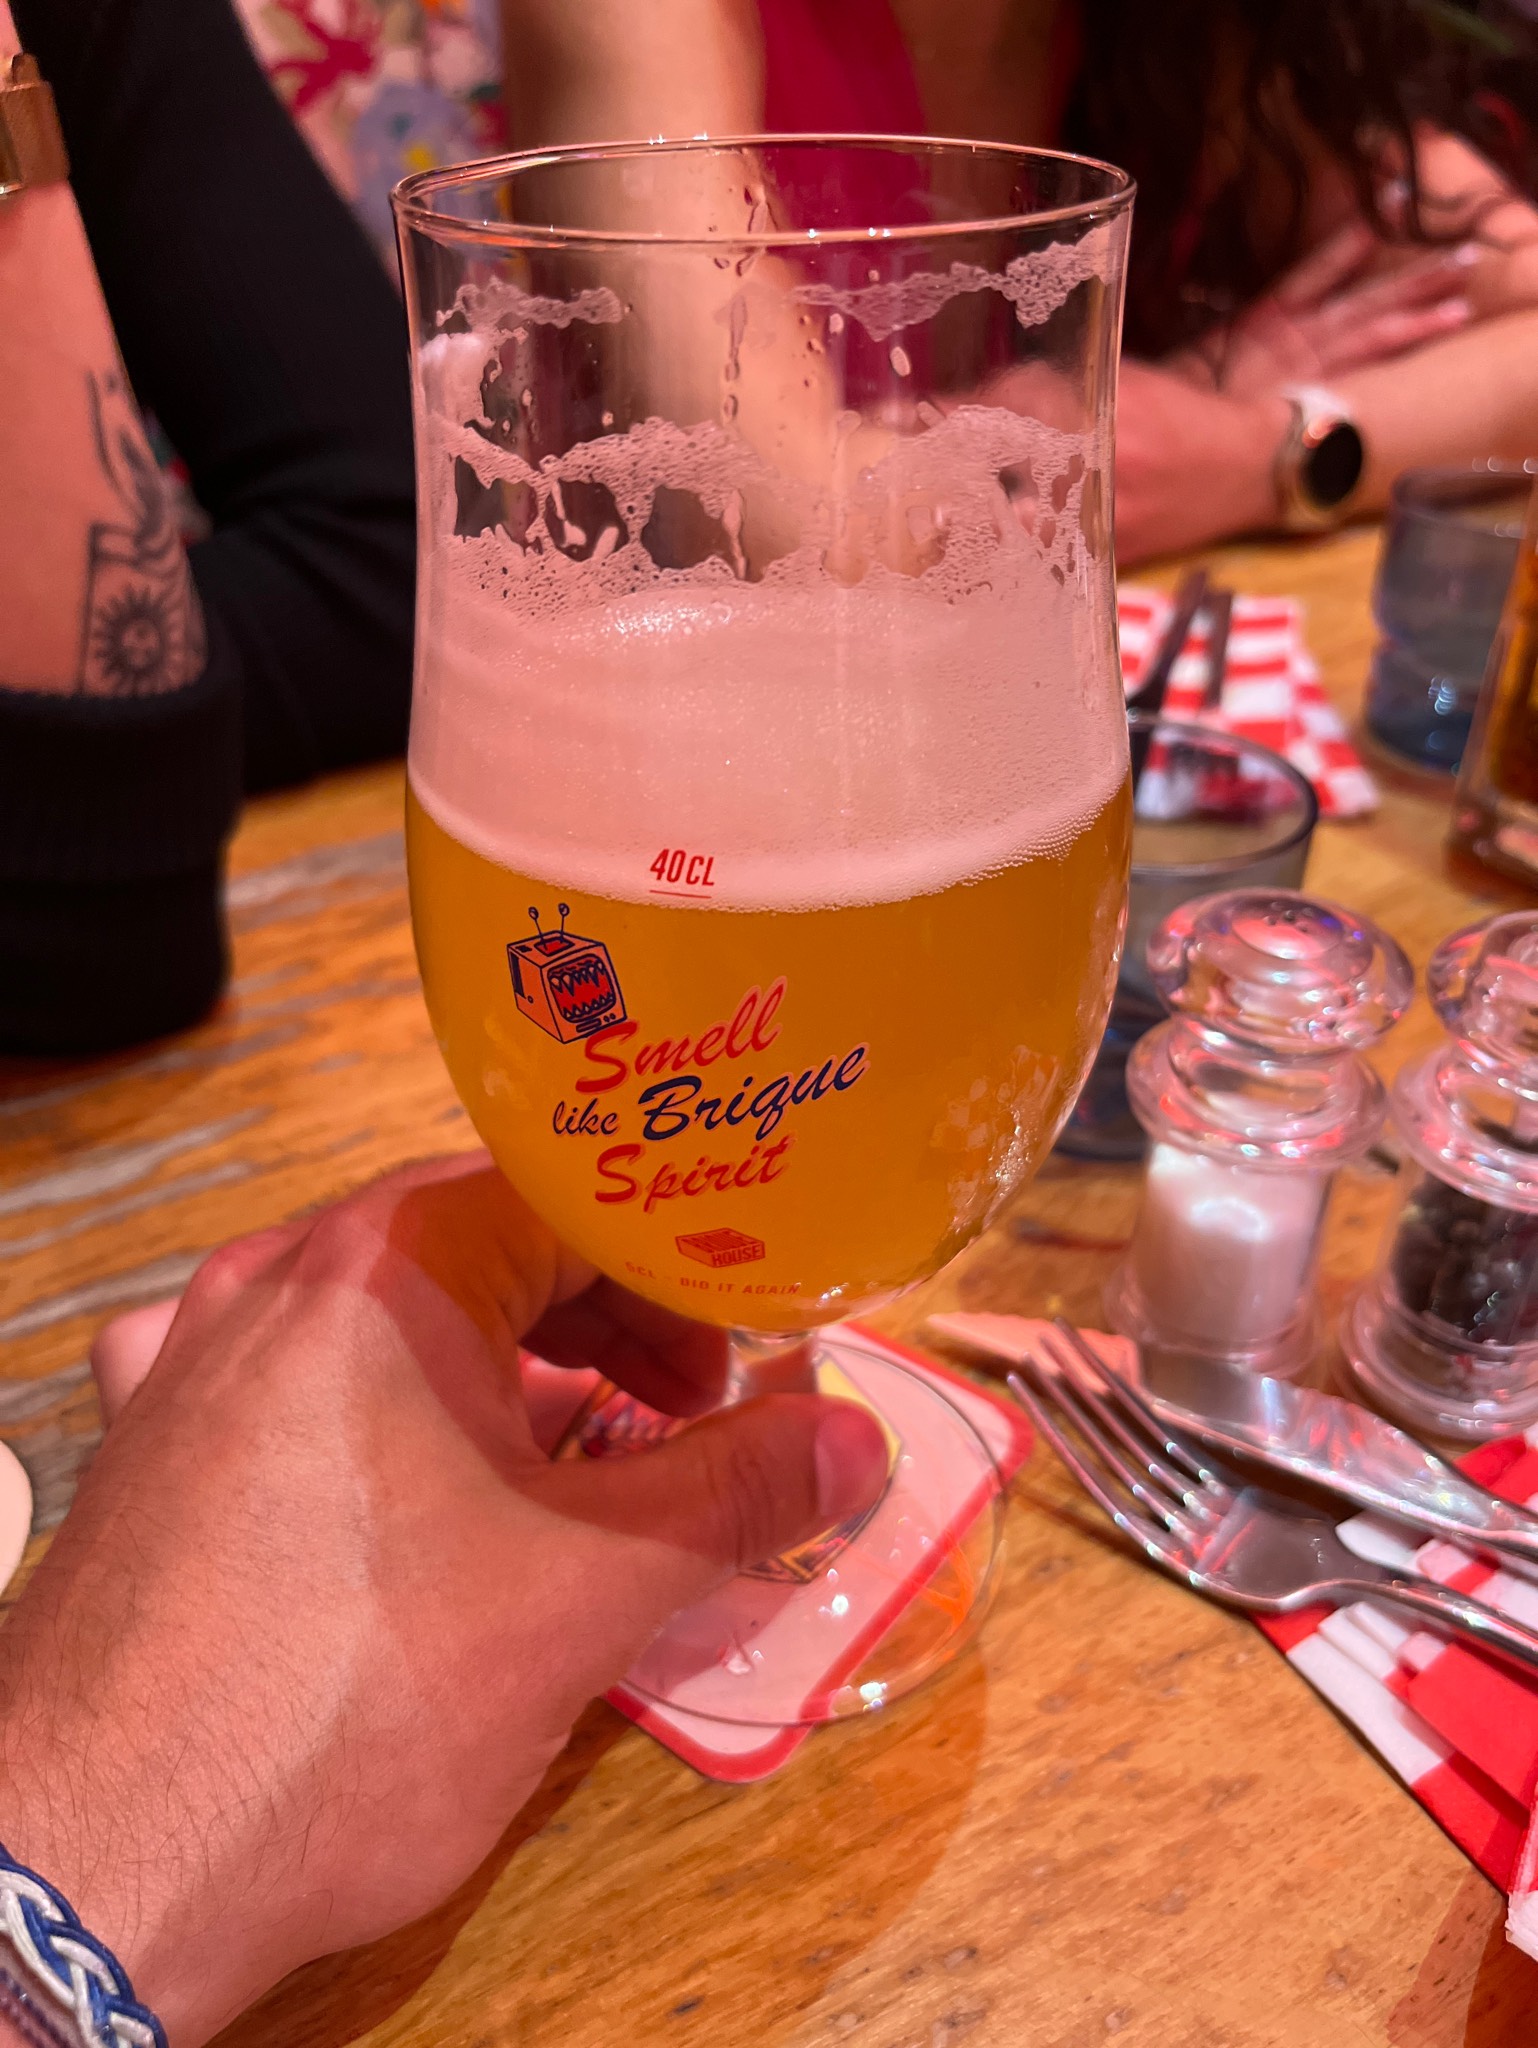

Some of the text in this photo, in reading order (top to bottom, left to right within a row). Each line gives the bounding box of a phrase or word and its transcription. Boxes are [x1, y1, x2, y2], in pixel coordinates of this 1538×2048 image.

[649, 848, 715, 887] 40CL
[574, 977, 788, 1093] Smell
[552, 1045, 868, 1142] like Brique
[594, 1137, 796, 1213] Spirit
[711, 1244, 762, 1267] HOUSE
[679, 1276, 710, 1290] DID
[717, 1282, 736, 1293] IT
[741, 1283, 801, 1295] AGAIN
